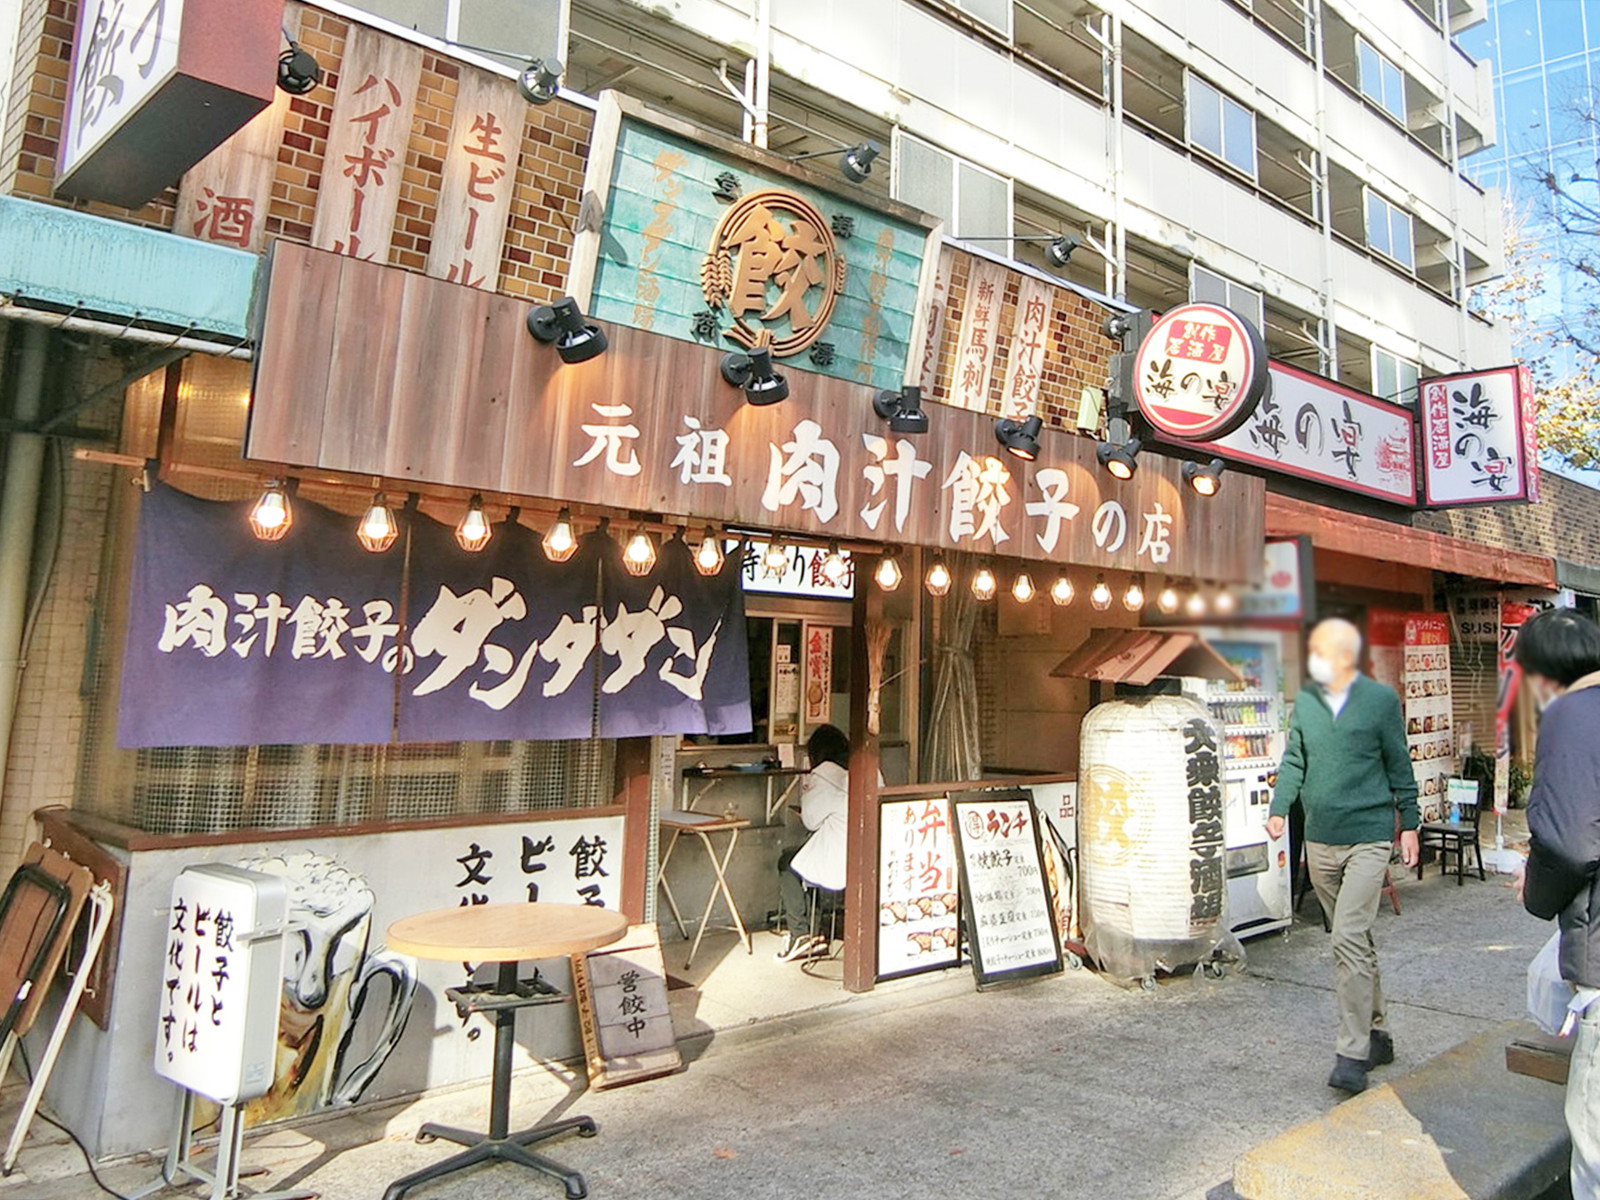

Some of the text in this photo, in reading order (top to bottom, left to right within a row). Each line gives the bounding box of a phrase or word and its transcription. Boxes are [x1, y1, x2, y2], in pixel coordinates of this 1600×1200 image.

[194, 187, 254, 248] 酒
[722, 202, 830, 332] 餃
[1165, 337, 1225, 362] 居酒屋
[1182, 322, 1217, 341] 創作
[1429, 385, 1450, 468] 創作居酒屋
[573, 403, 1173, 565] 元祖肉汁餃子の店
[903, 805, 916, 893] あります
[918, 800, 945, 893] 弁当
[987, 808, 1028, 839] ランチ
[1183, 718, 1223, 918] 大衆餃子酒場
[162, 897, 188, 1063] 文化です。
[182, 902, 211, 1052] ビールは
[211, 908, 234, 1026] 餃子と
[617, 970, 647, 1038] 営餃中
